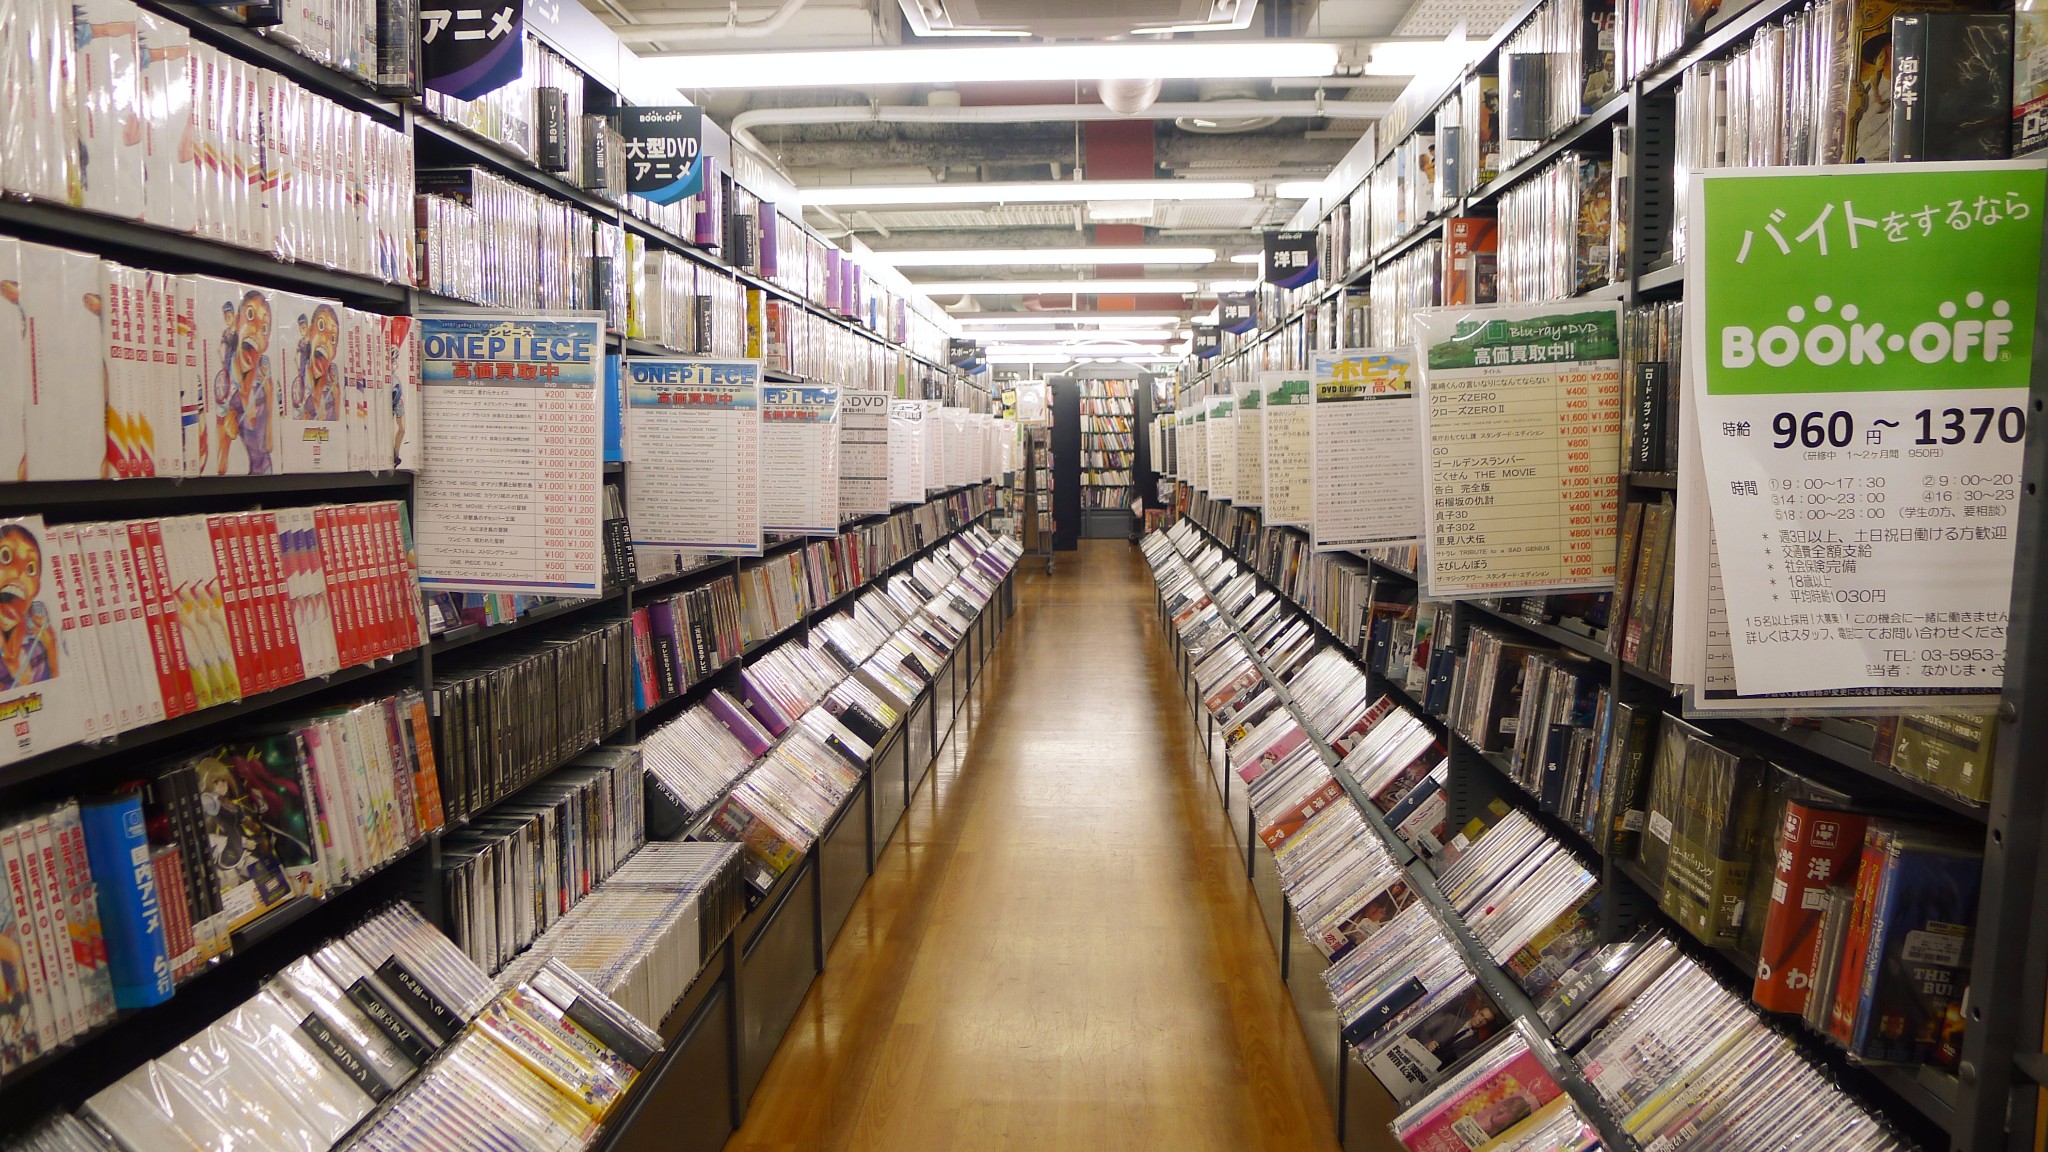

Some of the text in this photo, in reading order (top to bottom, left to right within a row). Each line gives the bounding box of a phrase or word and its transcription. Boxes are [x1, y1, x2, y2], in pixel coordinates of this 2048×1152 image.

[421, 6, 514, 44] アニメ
[1901, 59, 1918, 121] ロッキー
[596, 132, 604, 168] ルパン三世
[626, 137, 698, 160] 大型DVD
[633, 161, 691, 181] アニメ
[1735, 191, 2030, 264] バイトをするなら
[1274, 250, 1308, 268] 洋画
[481, 329, 534, 337] ワンピース
[1474, 341, 1575, 366] 高価買取中!!
[452, 362, 560, 381] 高価買取中
[1372, 377, 1398, 394] 高く
[657, 392, 733, 405] 高価買取中
[1432, 393, 1496, 404] クローズZERO
[1722, 422, 1750, 437] 時給
[1772, 411, 1854, 449] 960
[1914, 406, 2026, 445] 1370
[1433, 447, 1448, 455] GO
[1433, 456, 1525, 468] ゴールデンスランバー
[1434, 468, 1536, 482] ごくせん THE MOVIE
[1434, 483, 1491, 494] 告白 完全版
[1730, 480, 1758, 496] 時間
[1435, 511, 1468, 521] 貞子3D
[1436, 523, 1475, 533] 貞子3D2
[1436, 535, 1486, 546] 里見八犬伝
[622, 525, 636, 573] ONE PIECE
[1782, 544, 1872, 559] 交通費全額支給
[1437, 559, 1488, 571] さびしんぼう
[1784, 559, 1857, 574] 社会保険完備
[1788, 575, 1832, 588] 18歳以上
[1790, 589, 1886, 604] 平均時給1030円
[1771, 848, 1794, 905] 洋画
[130, 844, 160, 934] 国内アニメ
[1785, 856, 1832, 990] 洋画 わ
